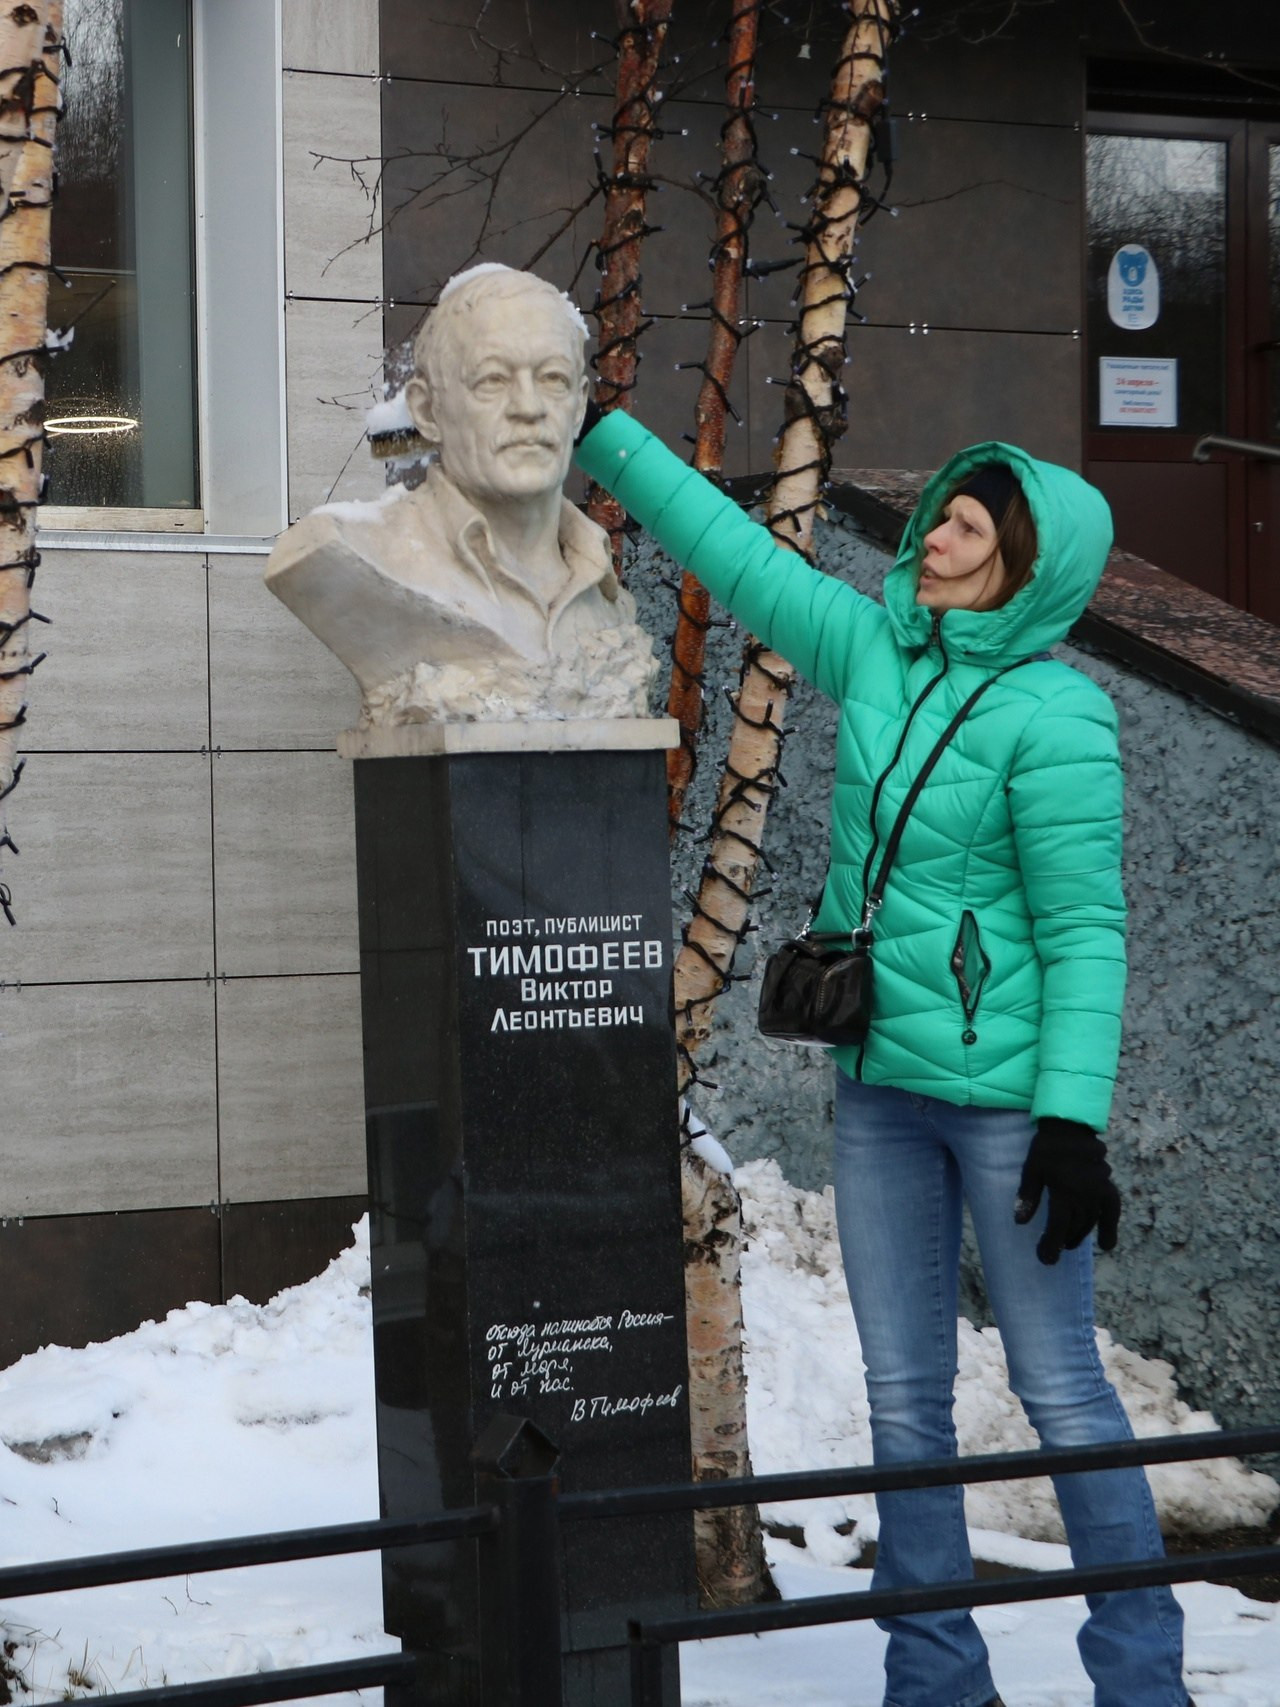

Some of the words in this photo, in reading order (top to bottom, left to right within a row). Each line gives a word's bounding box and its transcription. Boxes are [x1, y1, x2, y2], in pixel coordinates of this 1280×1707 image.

[486, 918, 540, 937] ПОЭТ,
[545, 914, 643, 935] ПУБЛИЦИСТ
[467, 940, 663, 976] ТИМОФЕЕВ
[488, 1342, 508, 1361] от
[492, 1362, 513, 1380] от
[521, 1357, 573, 1379] моря,
[491, 1384, 502, 1398] и
[511, 1377, 530, 1396] от
[539, 1377, 574, 1394] нас.
